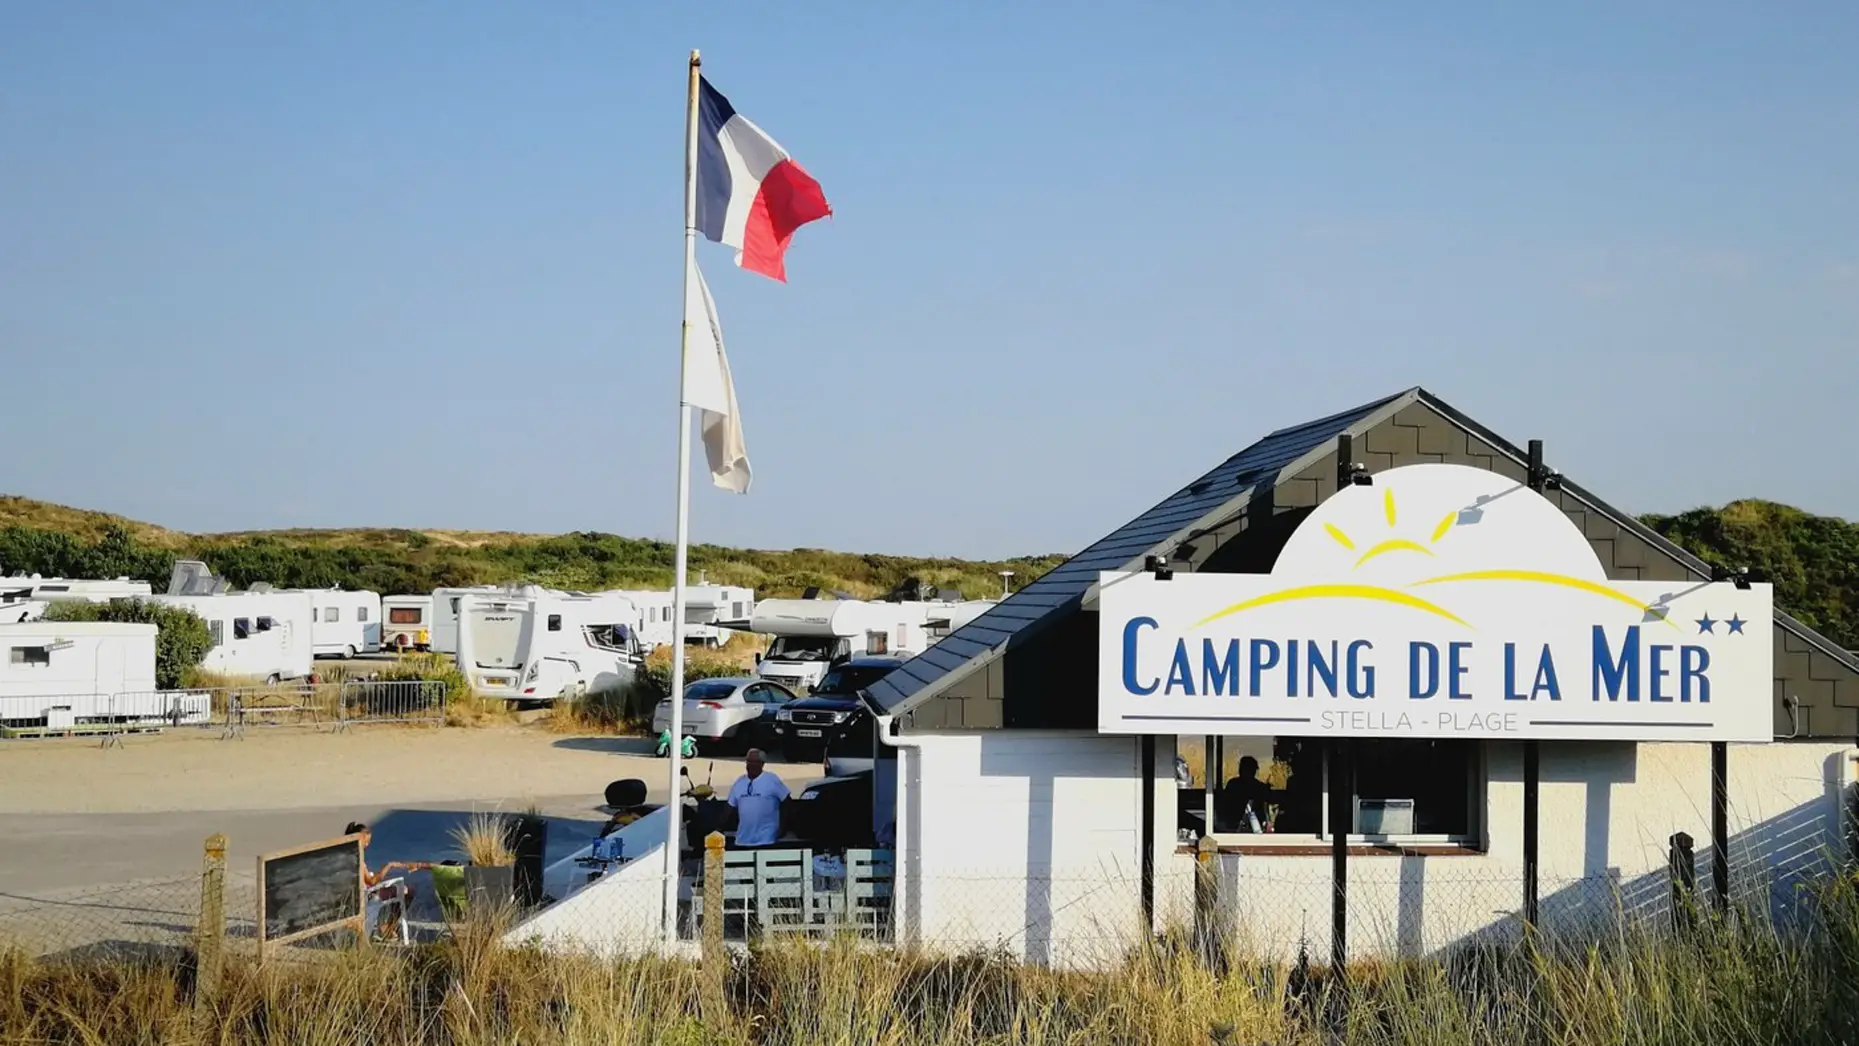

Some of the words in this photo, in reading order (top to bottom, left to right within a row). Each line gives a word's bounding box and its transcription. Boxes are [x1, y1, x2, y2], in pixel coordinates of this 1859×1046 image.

[1121, 615, 1376, 699] CAMPING
[1408, 640, 1473, 700] DE
[1503, 642, 1563, 702] LA
[1591, 624, 1711, 704] MER
[1320, 710, 1413, 730] STELLA
[1437, 712, 1518, 732] PLAGE
